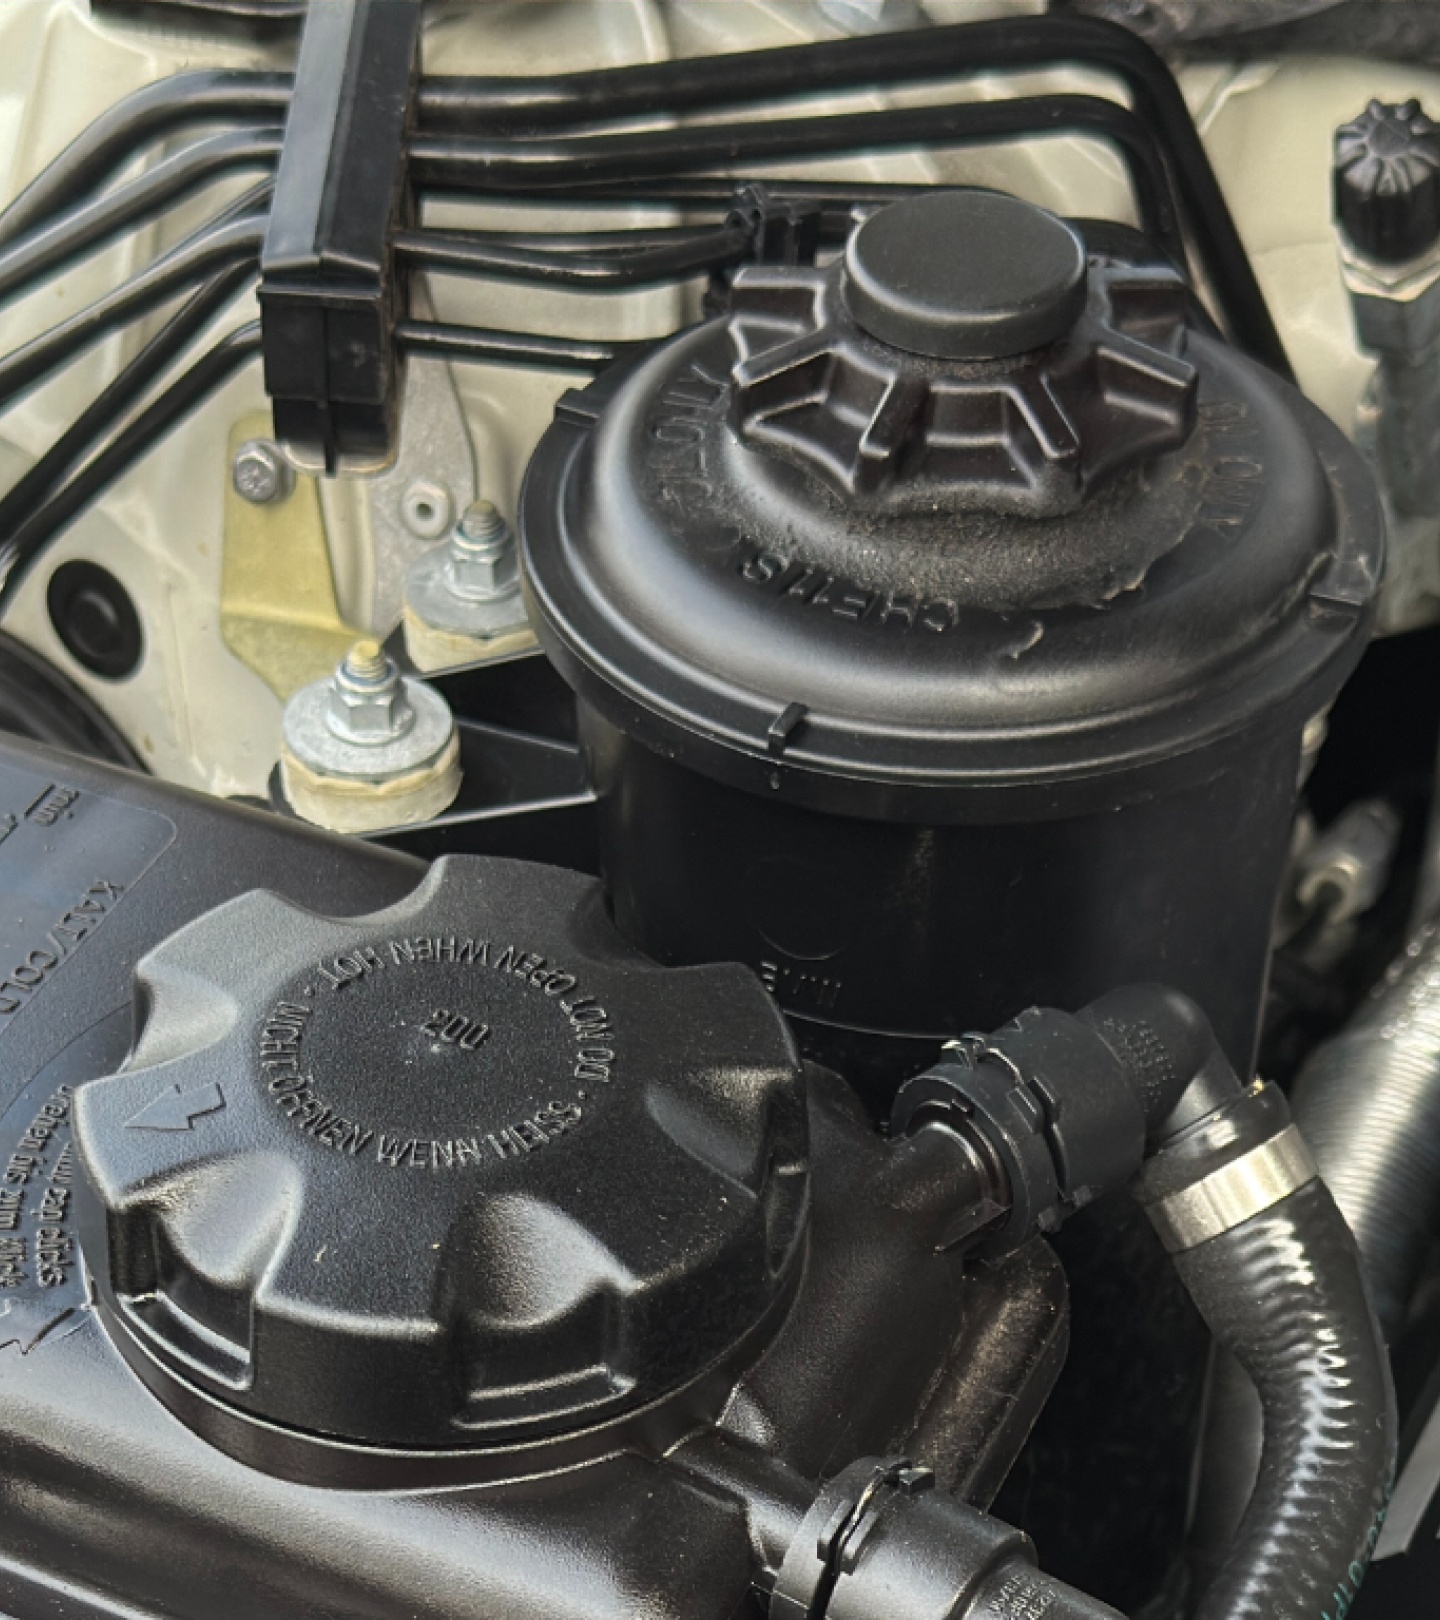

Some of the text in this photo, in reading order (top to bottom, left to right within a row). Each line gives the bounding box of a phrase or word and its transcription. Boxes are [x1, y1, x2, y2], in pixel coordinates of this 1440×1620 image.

[33, 784, 80, 828] min
[316, 936, 615, 1082] DO NOT OPEN WHEN HOT
[261, 1000, 310, 1070] NICHT
[376, 1133, 483, 1169] WENN
[486, 1100, 582, 1160] HEISS
